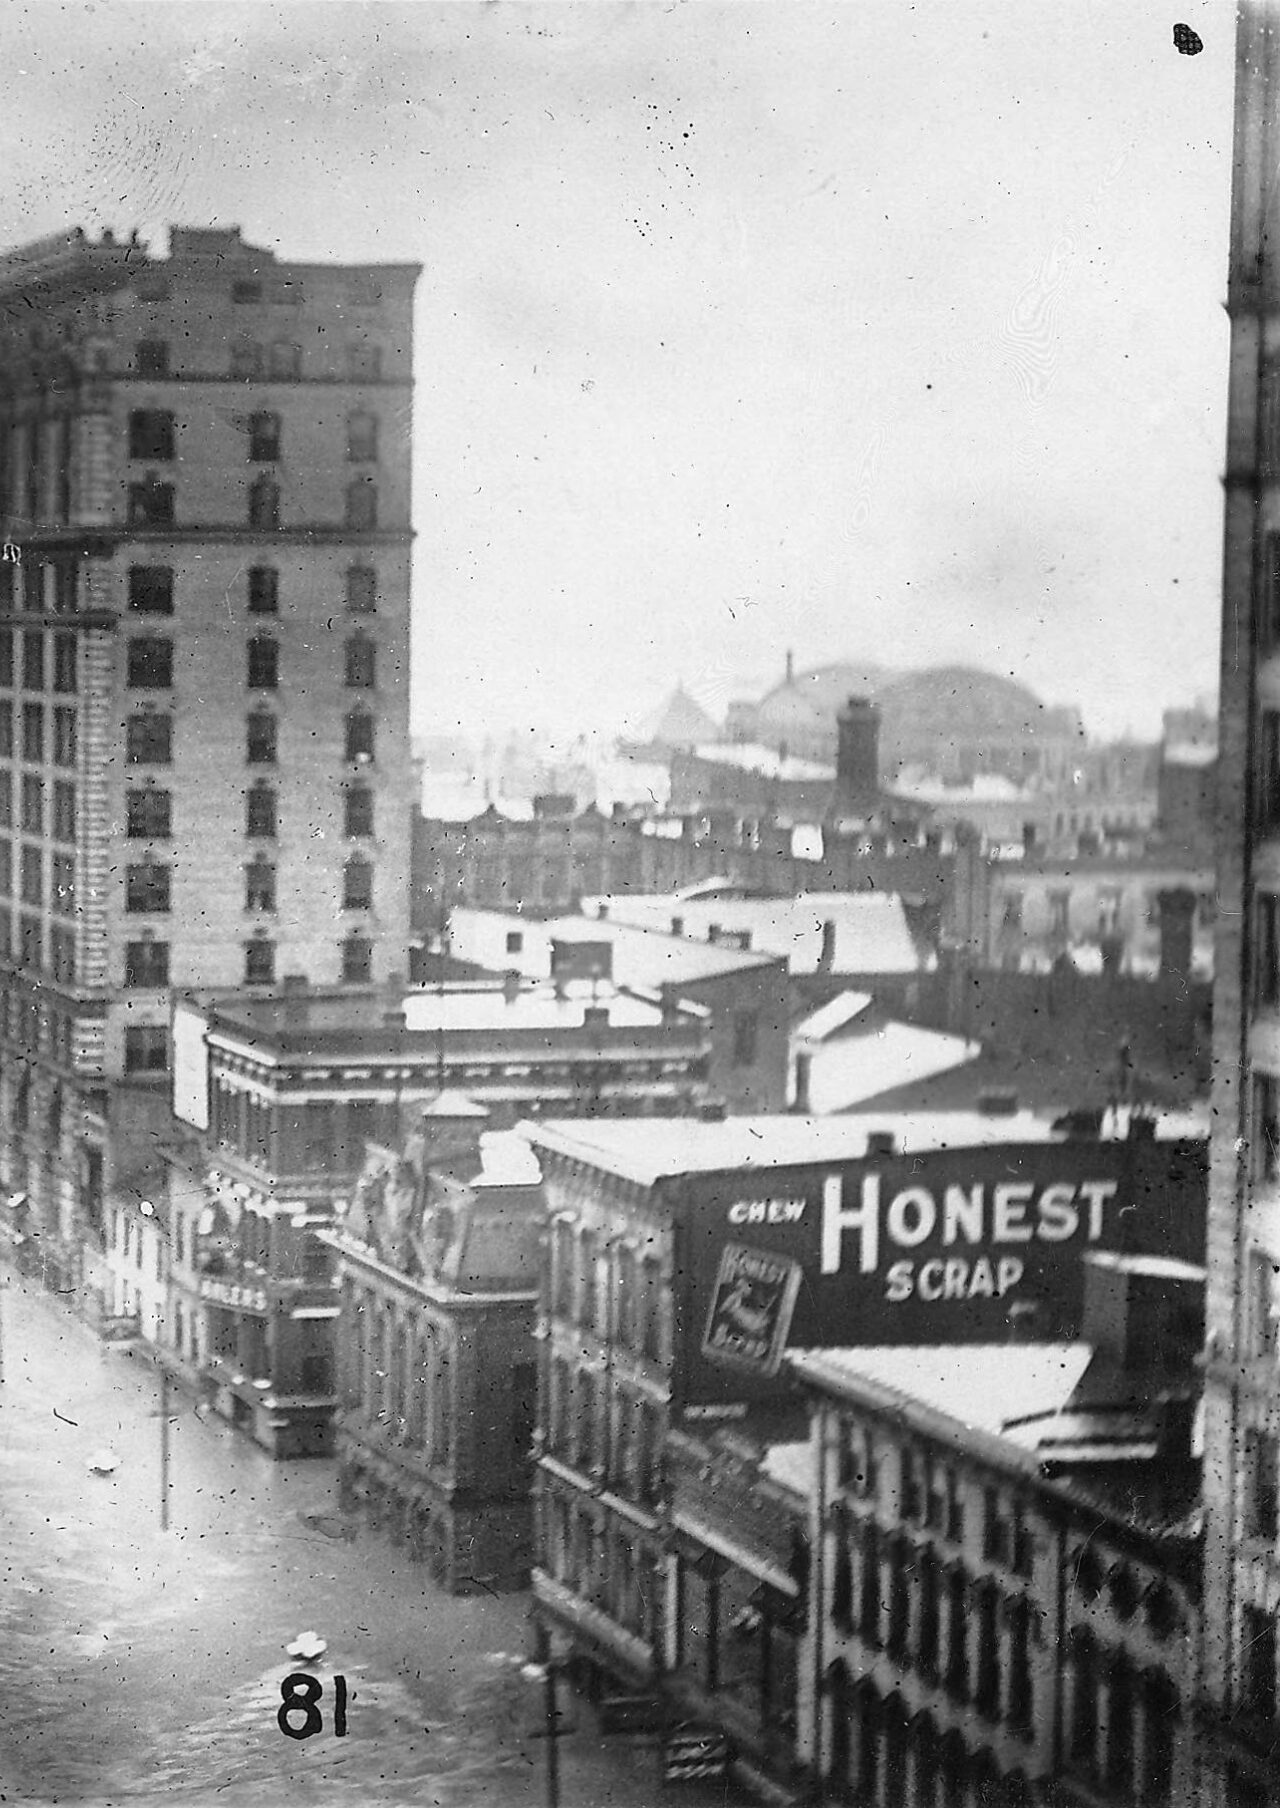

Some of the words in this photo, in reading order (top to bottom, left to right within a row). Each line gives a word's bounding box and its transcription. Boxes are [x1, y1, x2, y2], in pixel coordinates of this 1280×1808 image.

[728, 1199, 807, 1225] CHEW
[821, 1174, 1119, 1275] HONEST
[886, 1255, 1025, 1302] SCRAP
